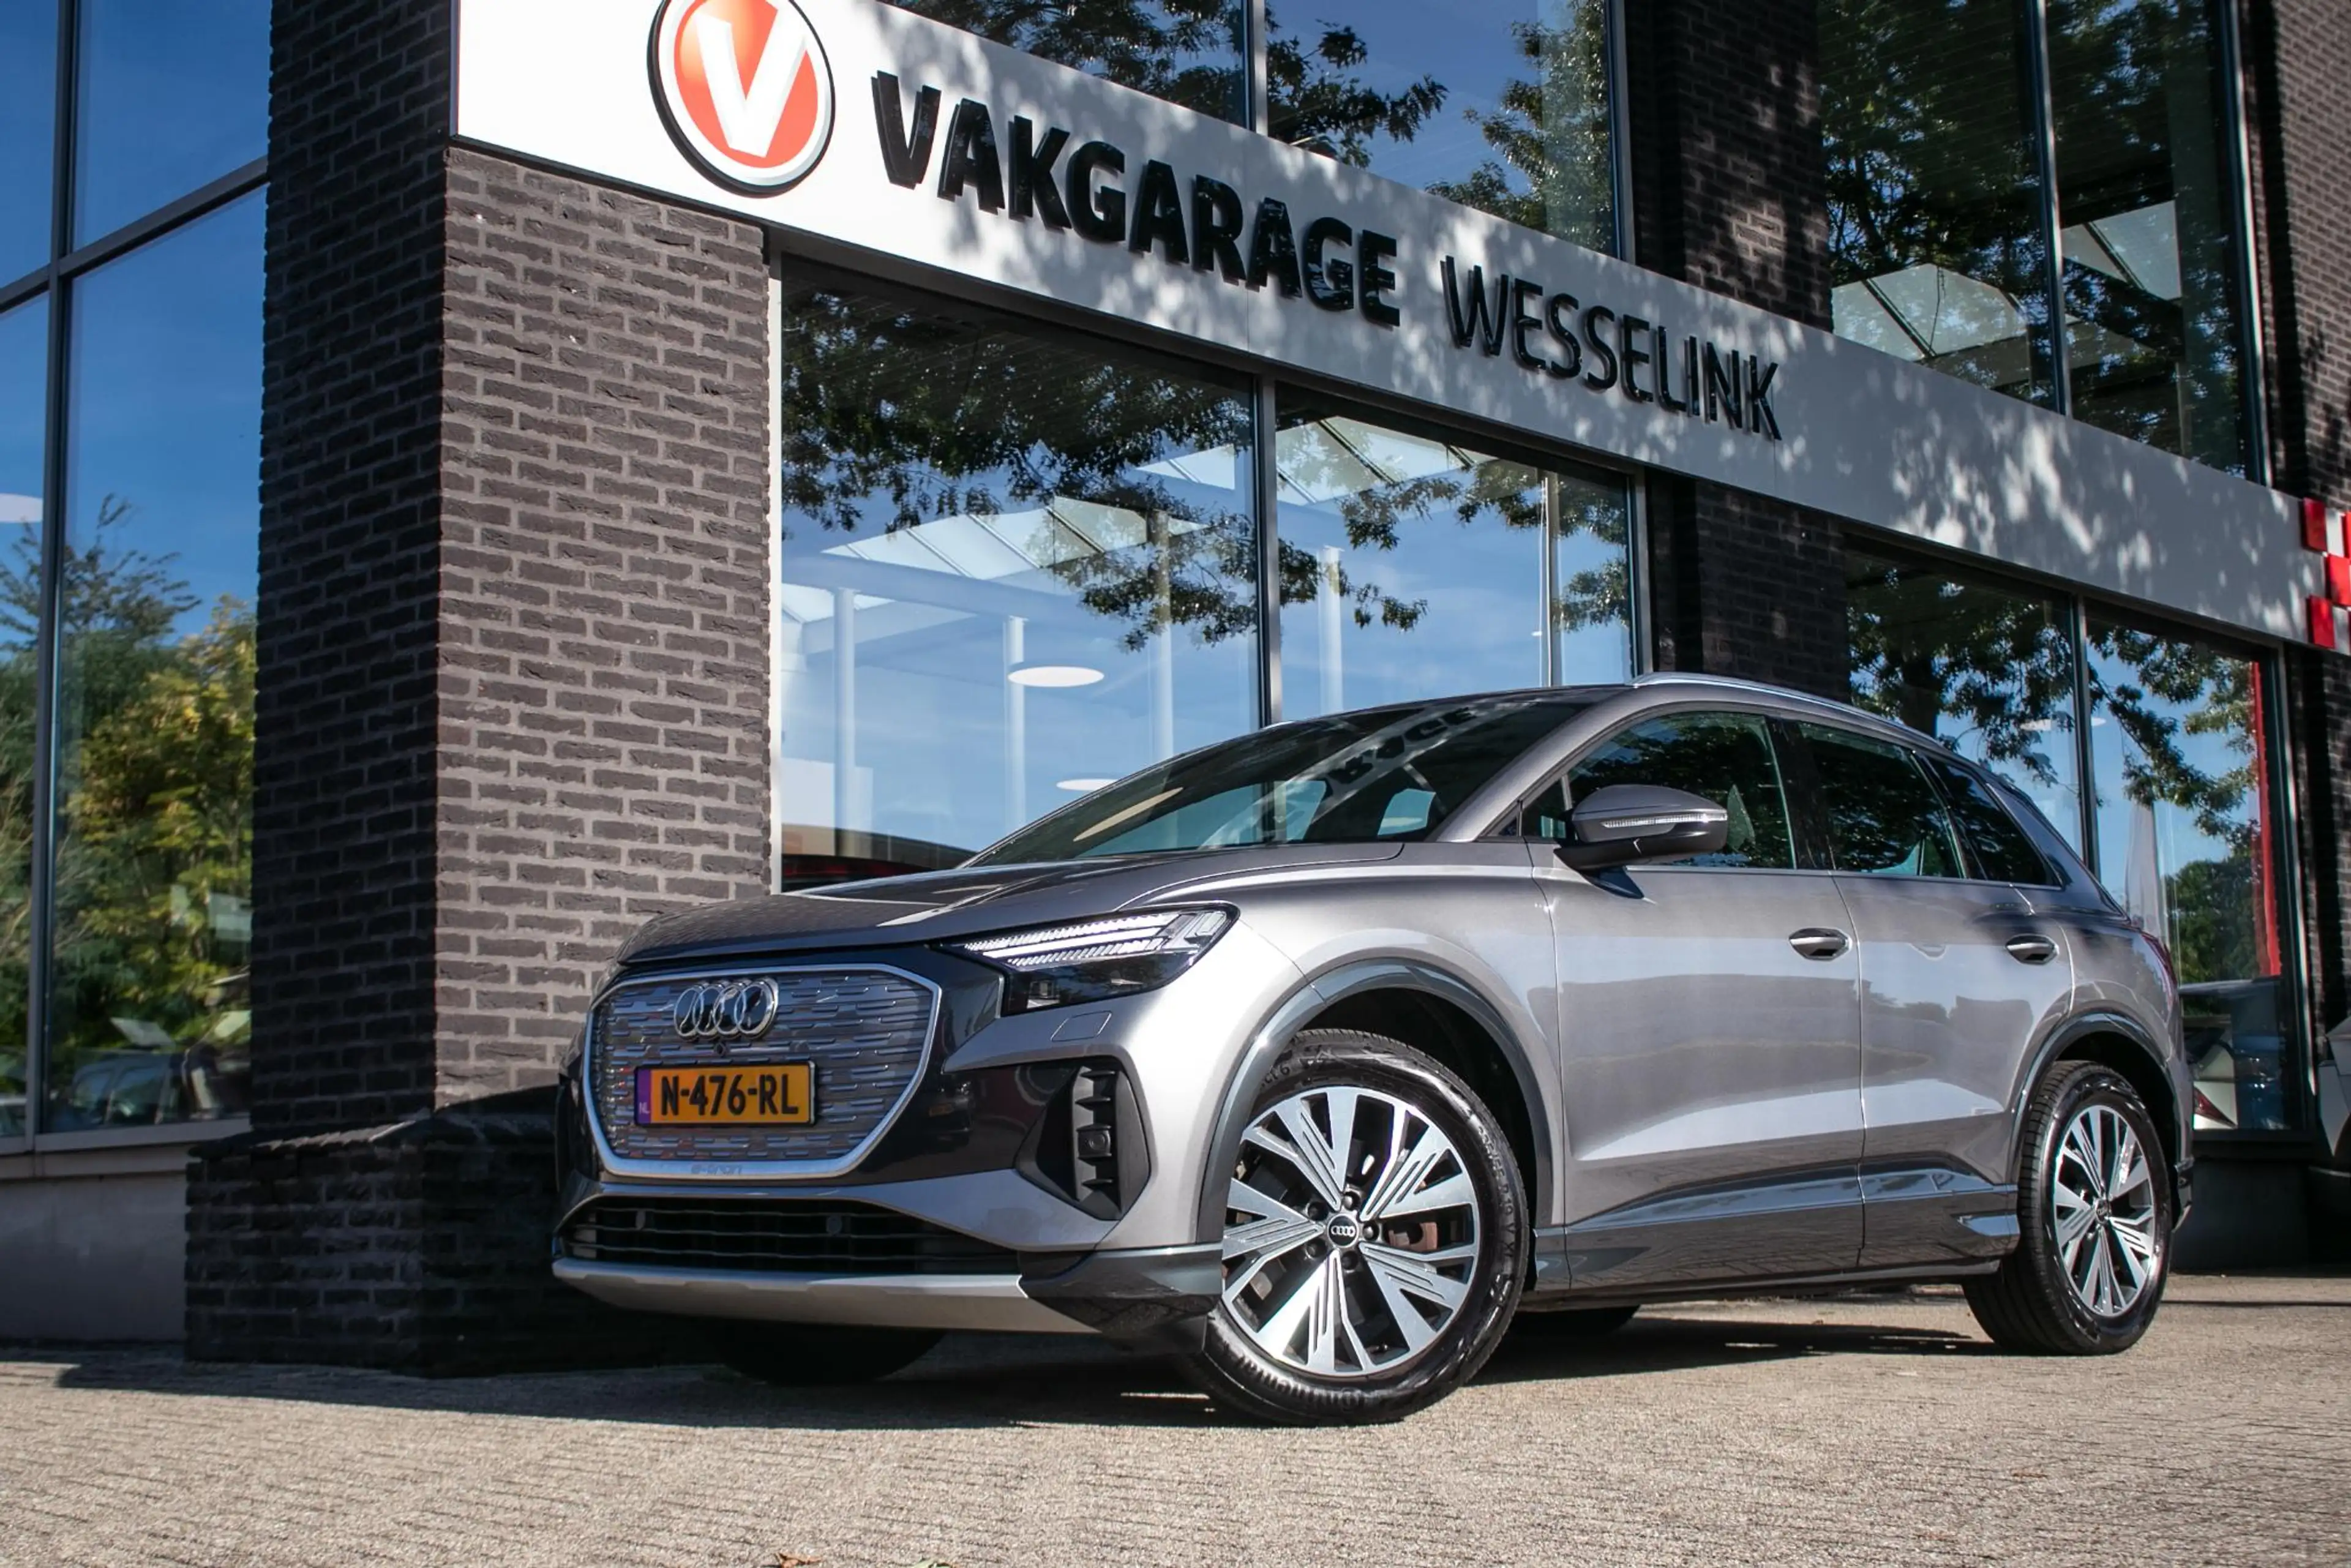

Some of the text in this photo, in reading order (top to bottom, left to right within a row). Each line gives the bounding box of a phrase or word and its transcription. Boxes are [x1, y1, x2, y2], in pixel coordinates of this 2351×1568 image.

[871, 70, 1782, 441] VAKGARAGE WESSELINK
[661, 1073, 799, 1116] N-476-RL
